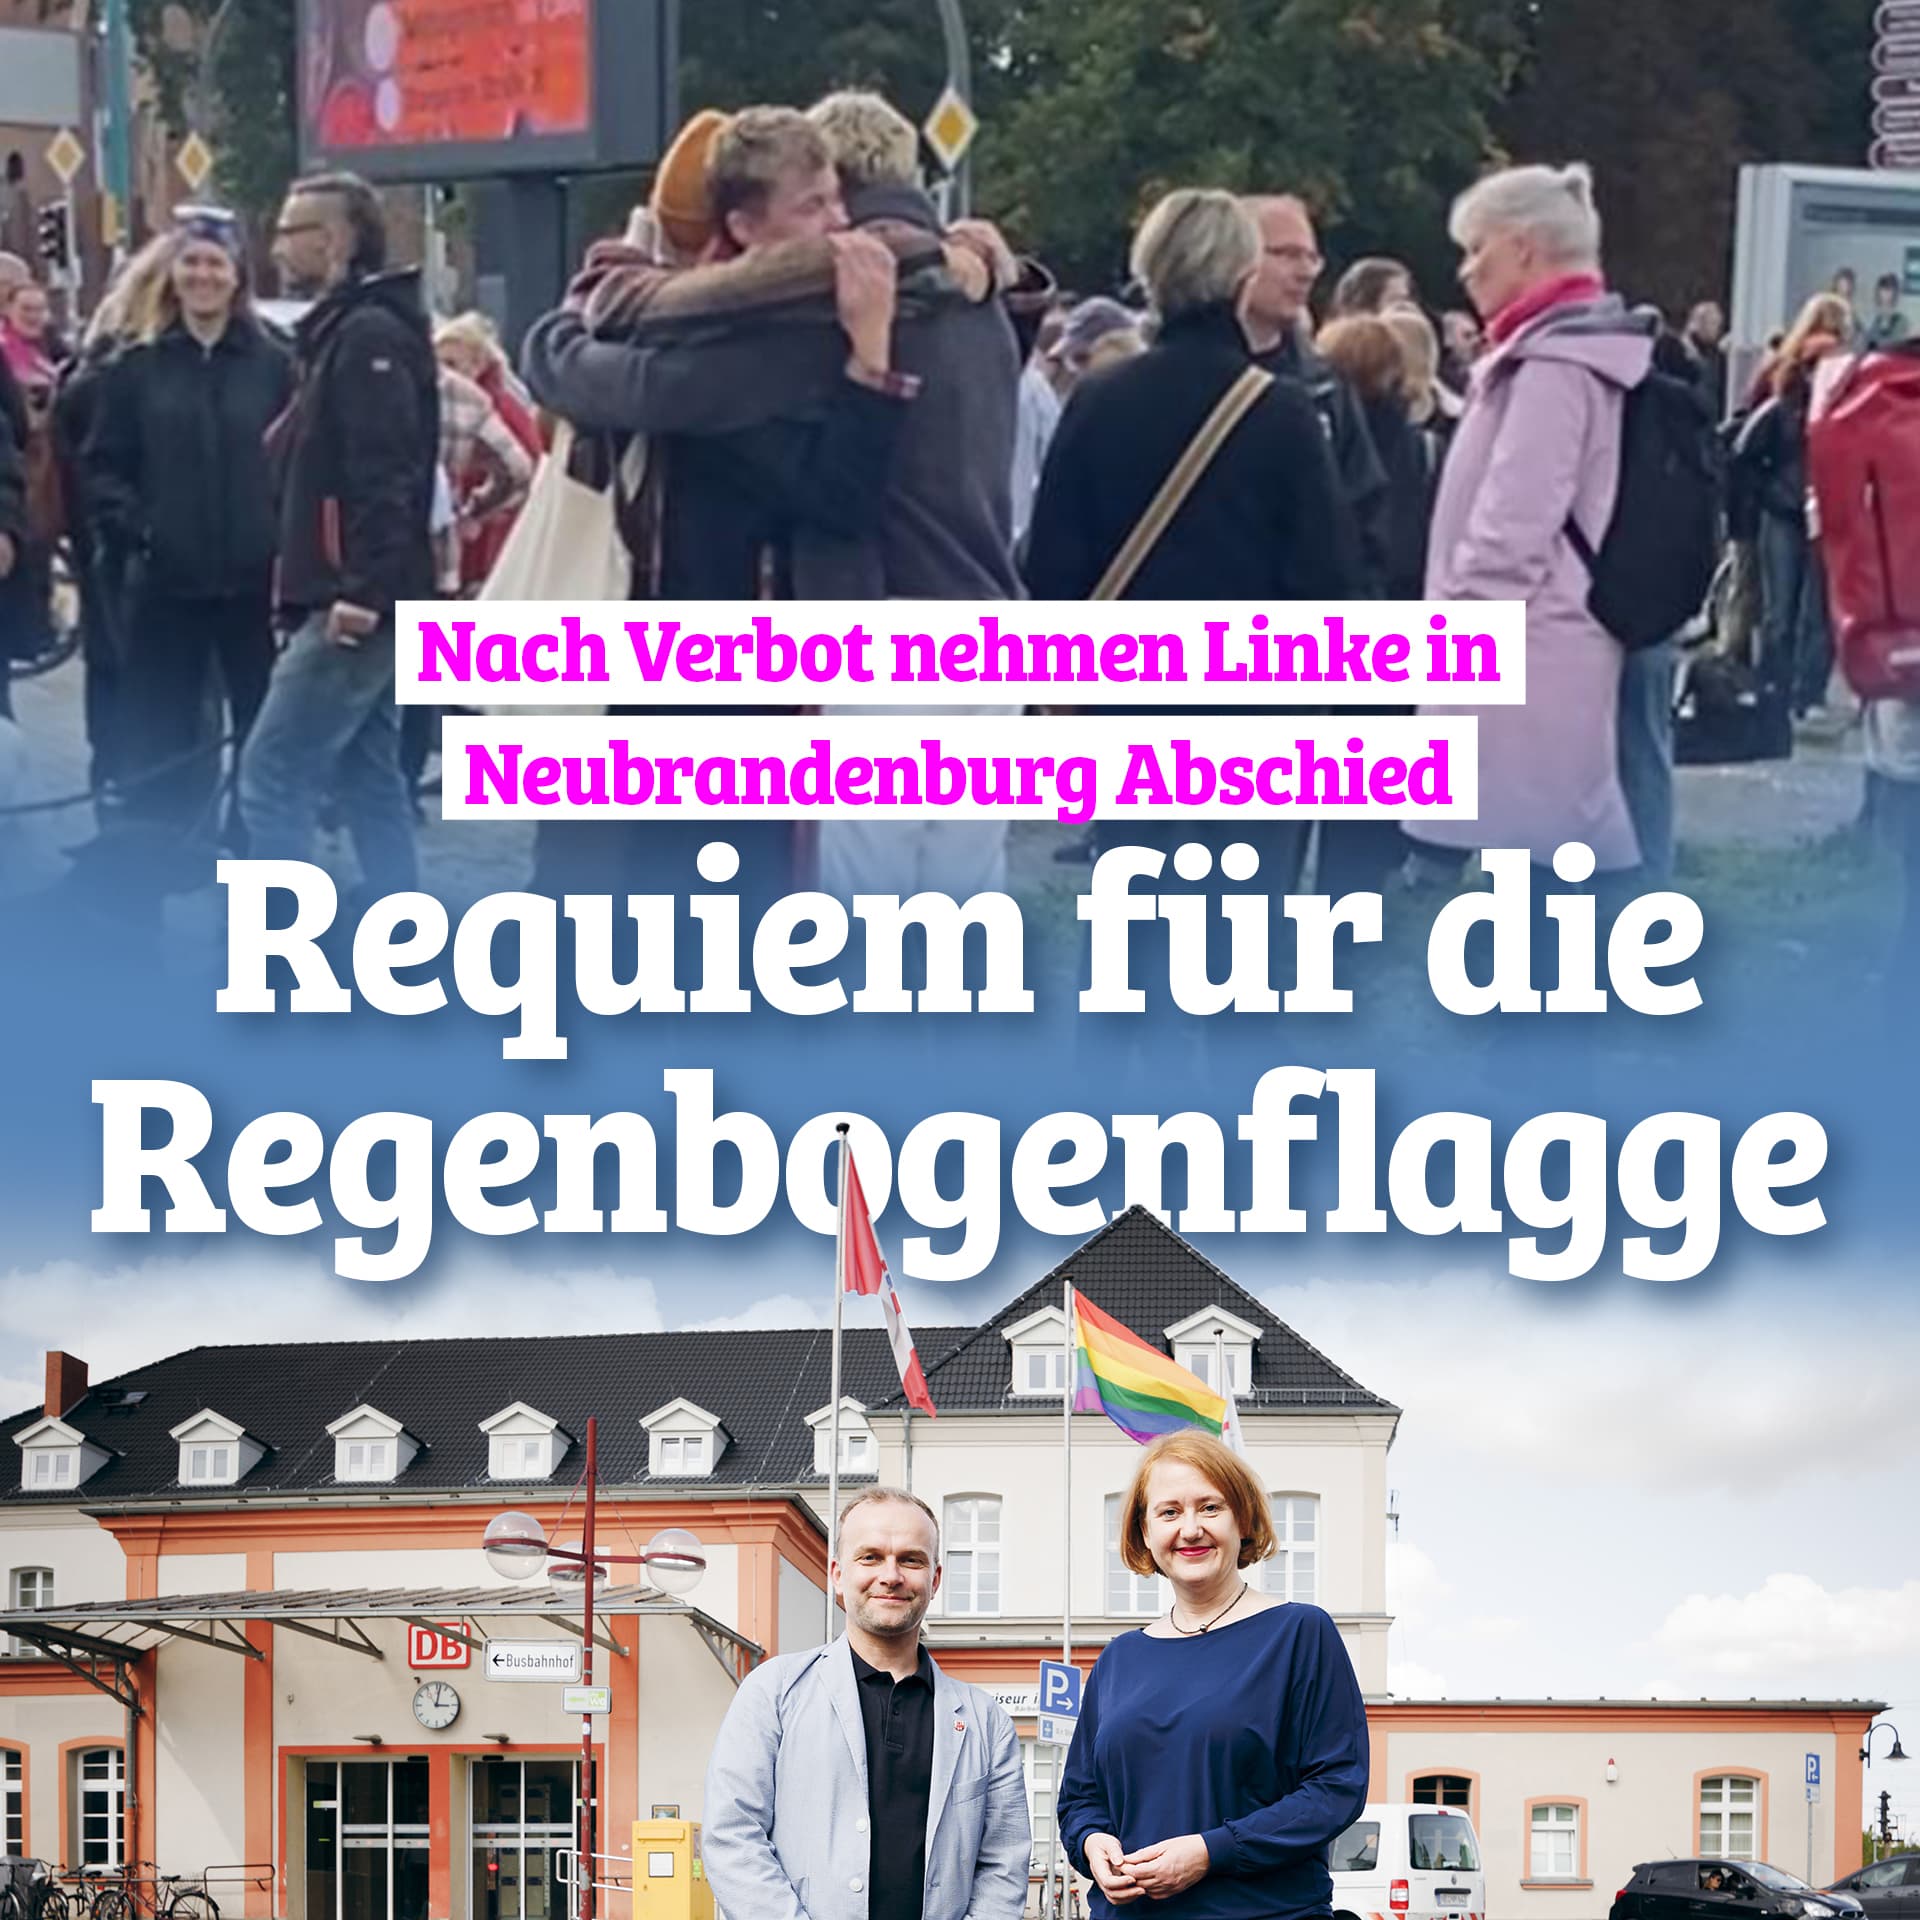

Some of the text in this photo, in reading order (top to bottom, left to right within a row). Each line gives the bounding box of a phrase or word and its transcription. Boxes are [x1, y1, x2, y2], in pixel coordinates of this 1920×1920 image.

[416, 1631, 462, 1660] DB
[506, 1653, 574, 1668] Busbahnhof
[991, 1692, 1027, 1704] iseur
[1046, 1668, 1069, 1707] P
[1808, 1757, 1816, 1780] P
